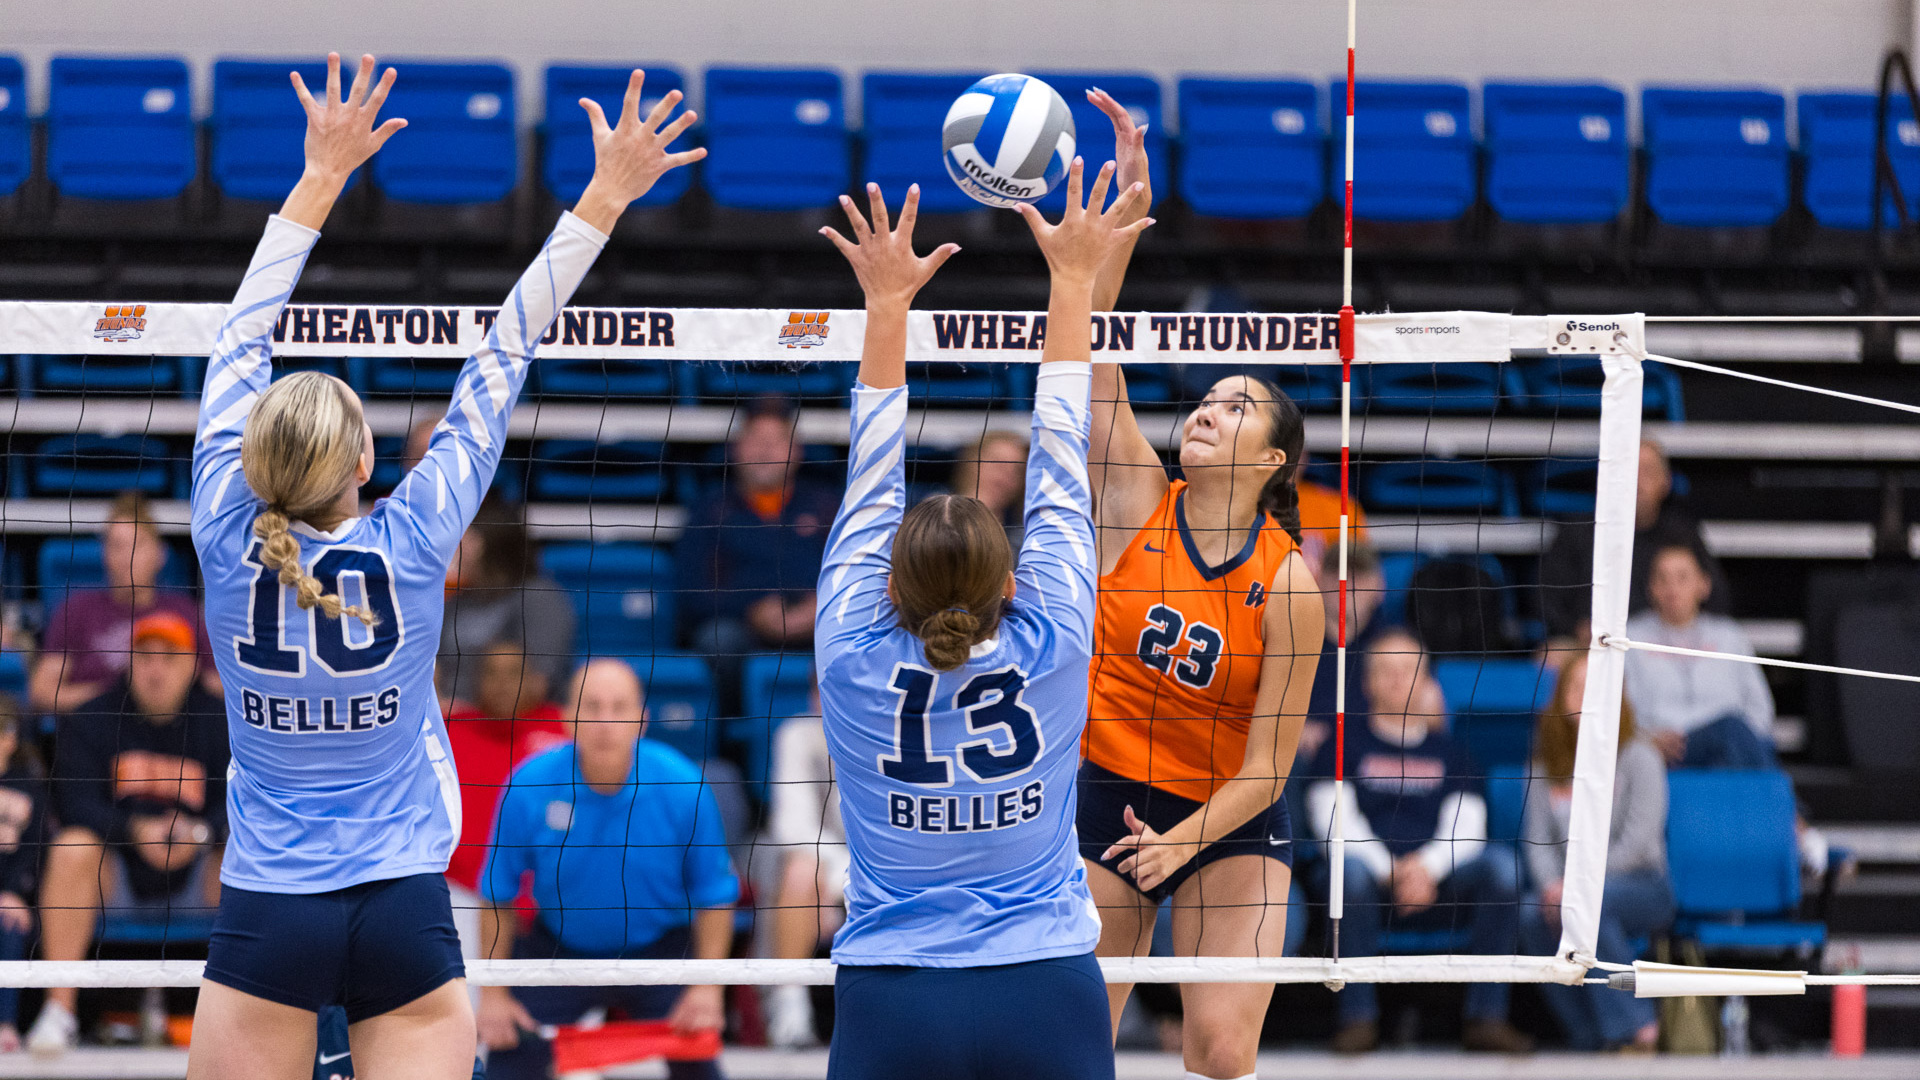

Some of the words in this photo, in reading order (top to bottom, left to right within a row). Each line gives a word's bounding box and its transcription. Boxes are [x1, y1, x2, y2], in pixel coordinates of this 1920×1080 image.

[964, 158, 1033, 197] molten
[933, 313, 1136, 351] WHEAON
[1150, 315, 1340, 351] THUNDER
[1395, 326, 1424, 335] sports
[1578, 322, 1620, 331] Senoh
[233, 536, 405, 678] 10
[1137, 603, 1224, 690] 23
[241, 684, 401, 735] BELLES
[877, 661, 1045, 788] 13
[888, 779, 1044, 834] BELLES
